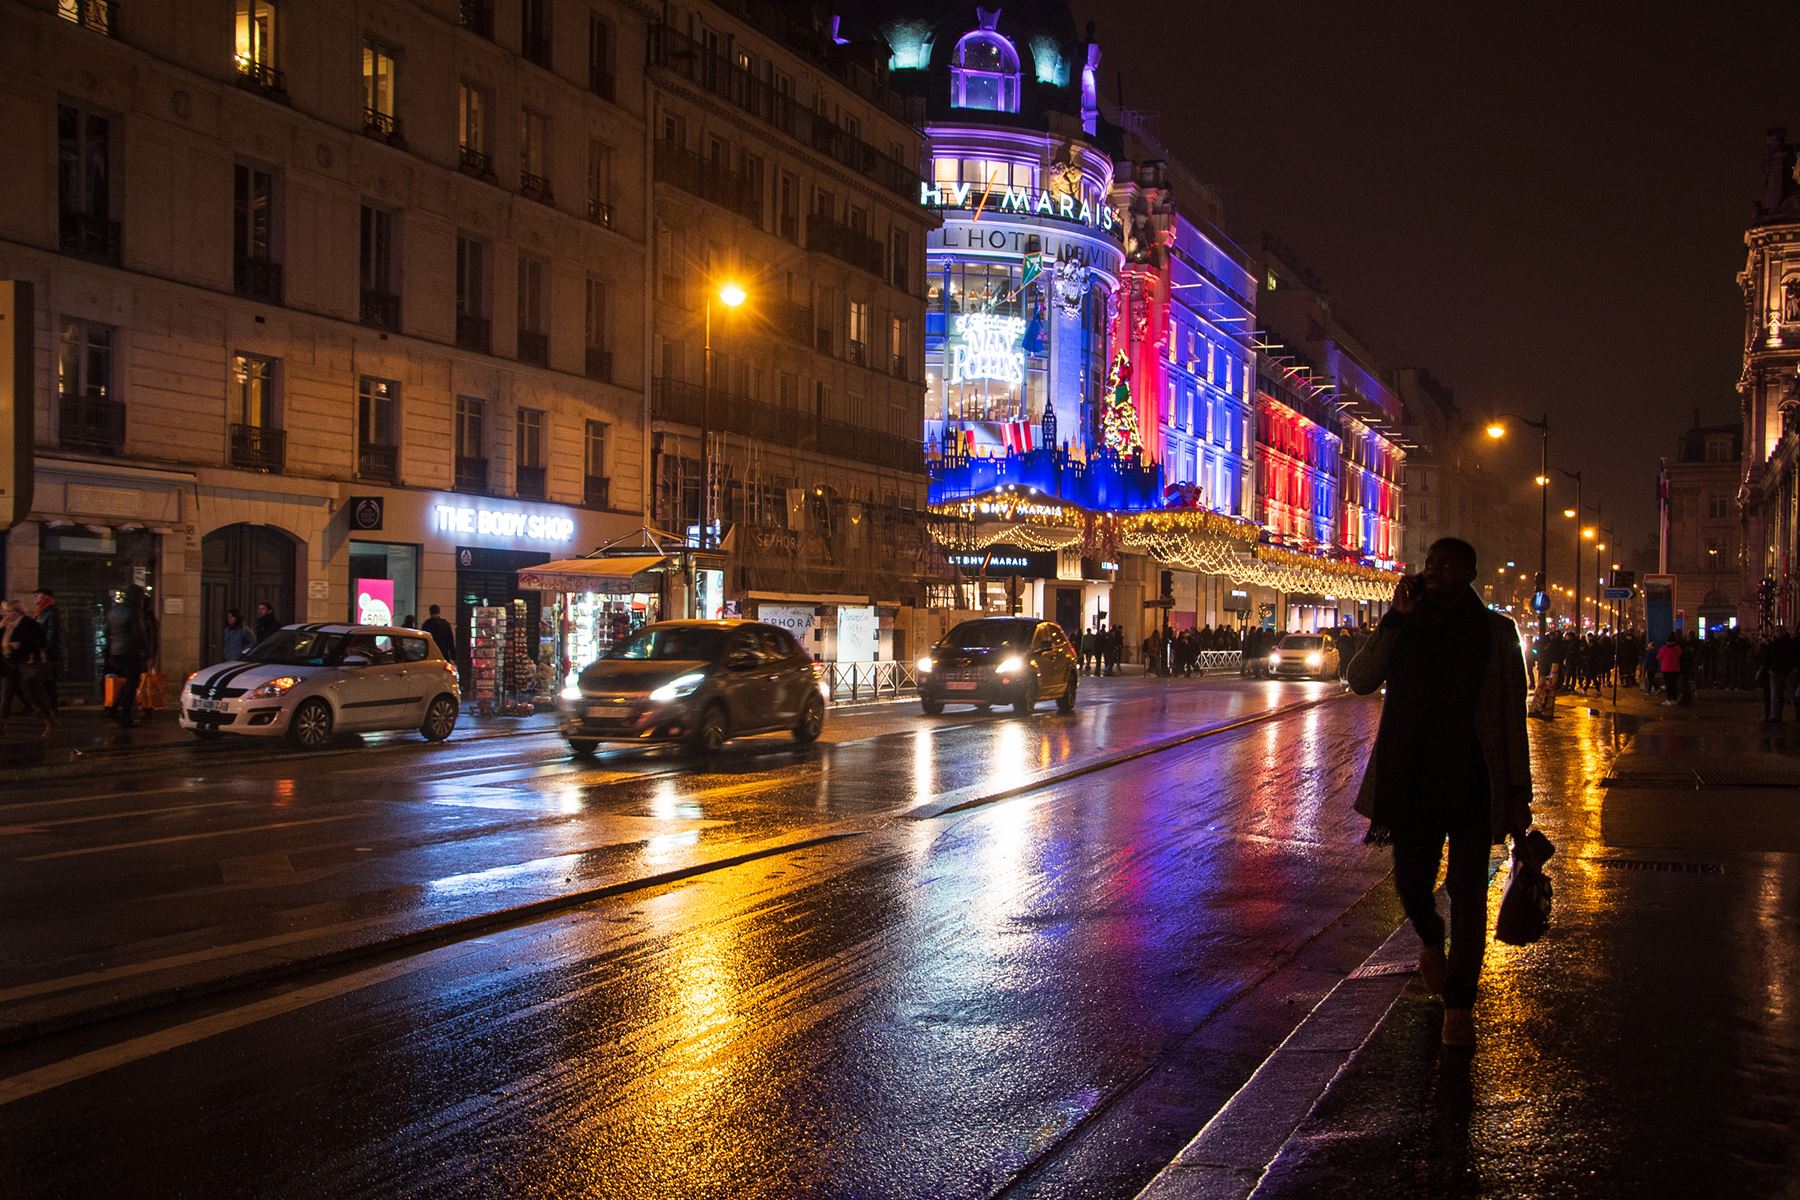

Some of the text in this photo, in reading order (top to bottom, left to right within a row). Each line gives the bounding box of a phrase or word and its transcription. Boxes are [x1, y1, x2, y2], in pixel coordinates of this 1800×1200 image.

[1001, 185, 1113, 231] MARAIS
[981, 503, 1009, 514] BHV
[1016, 504, 1063, 517] MARAIS
[436, 505, 574, 541] THE BODY SHOP
[962, 556, 985, 565] BHV
[990, 557, 1028, 566] MARAIS
